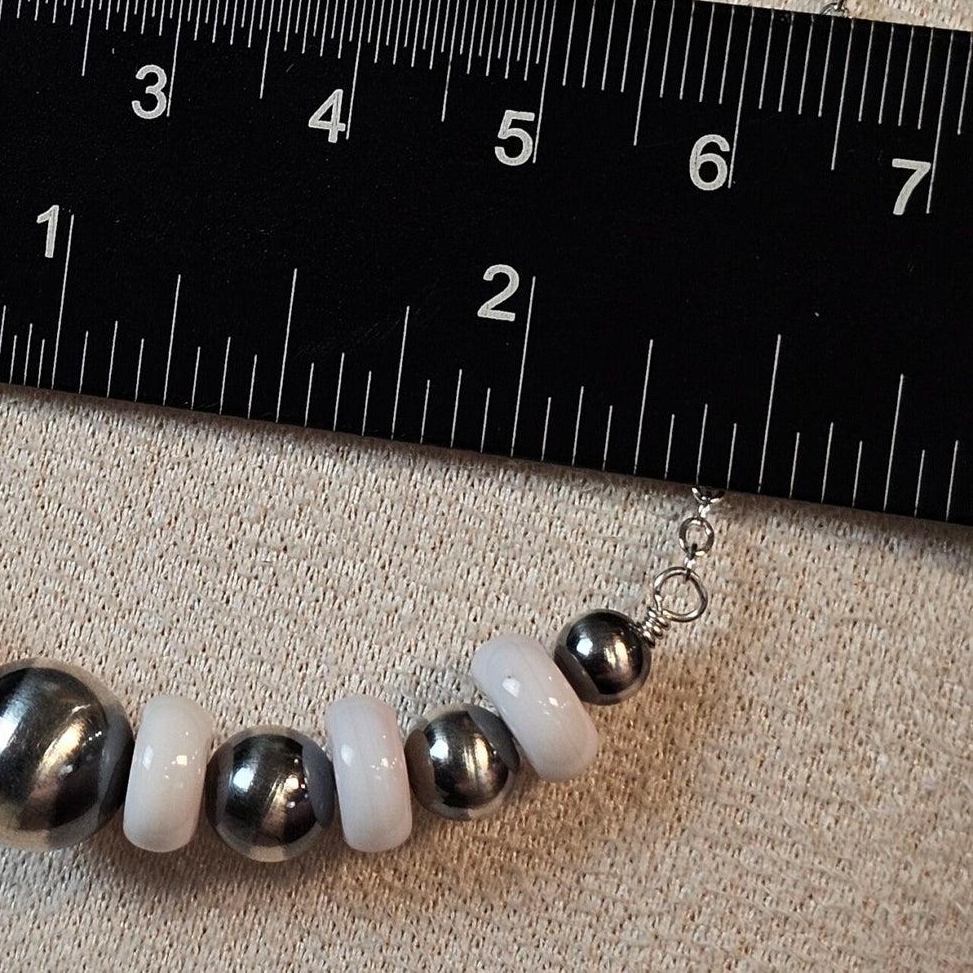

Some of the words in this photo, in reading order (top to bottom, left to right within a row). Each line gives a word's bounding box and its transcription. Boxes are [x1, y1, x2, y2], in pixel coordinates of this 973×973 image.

[131, 63, 168, 120] 3
[307, 88, 347, 144] 4
[494, 109, 536, 167] 5
[689, 133, 731, 191] 6
[891, 158, 932, 216] 7
[36, 204, 60, 259] 1
[476, 263, 520, 322] 2
